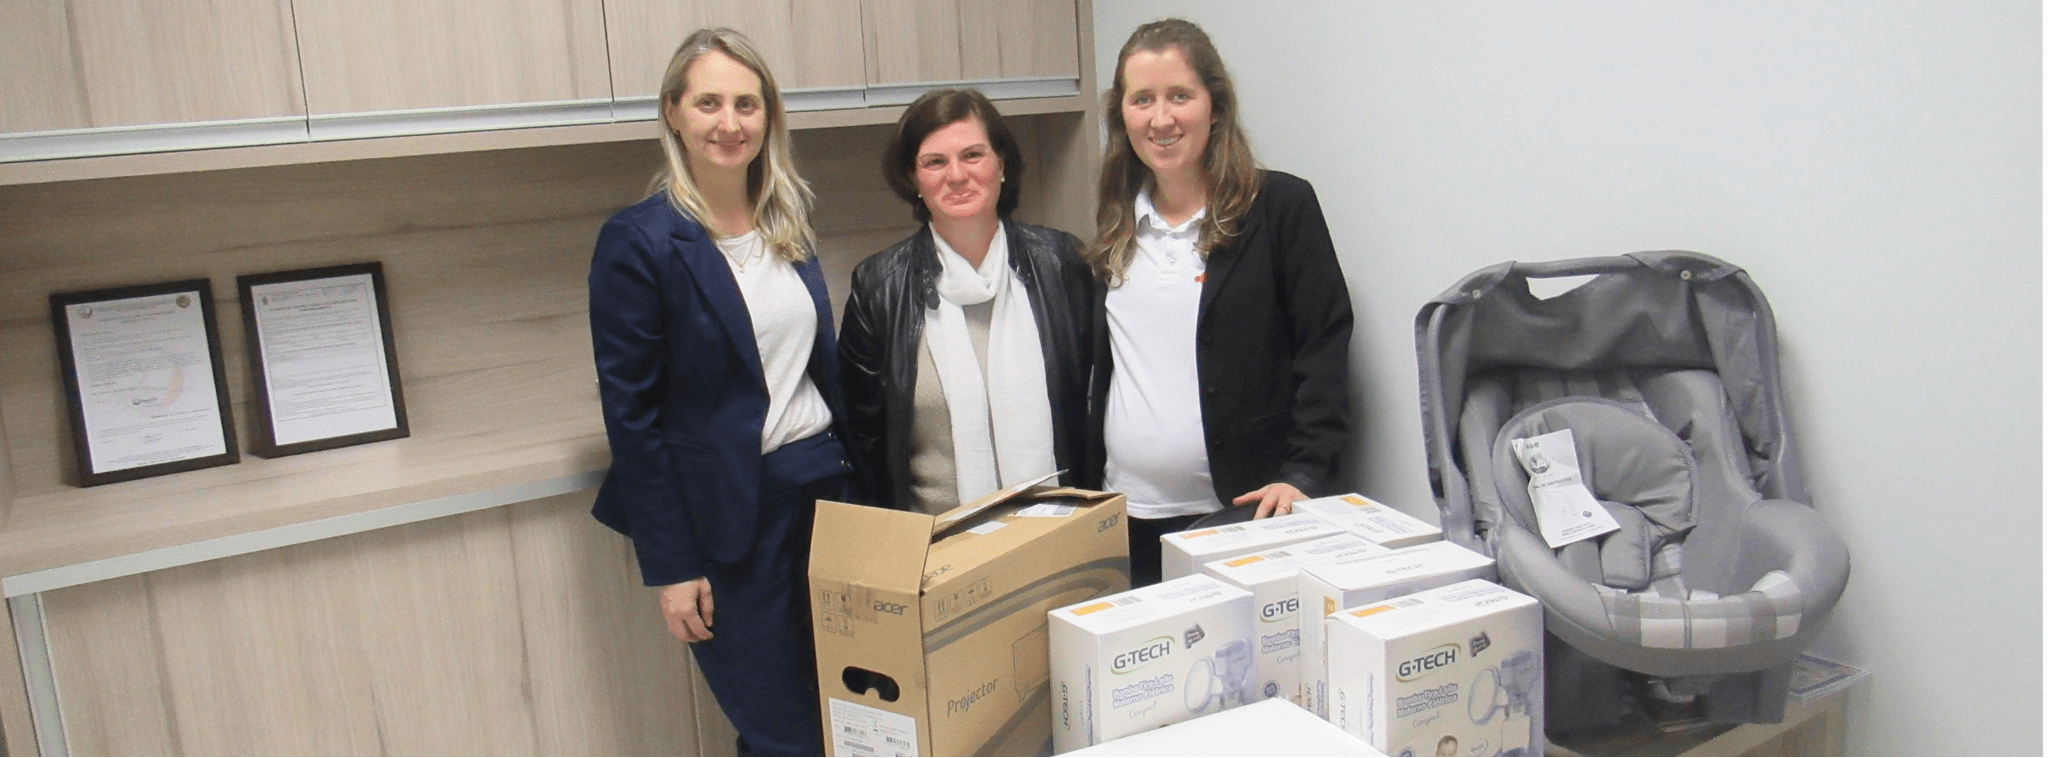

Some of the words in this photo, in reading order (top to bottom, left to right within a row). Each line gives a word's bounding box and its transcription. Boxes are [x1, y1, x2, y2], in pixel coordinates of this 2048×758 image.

[1097, 511, 1122, 533] acer
[873, 600, 908, 616] acer
[946, 678, 998, 717] Projector
[1112, 683, 1140, 700] Bomba
[1112, 693, 1143, 709] Materno
[1143, 684, 1175, 700] Elétrica
